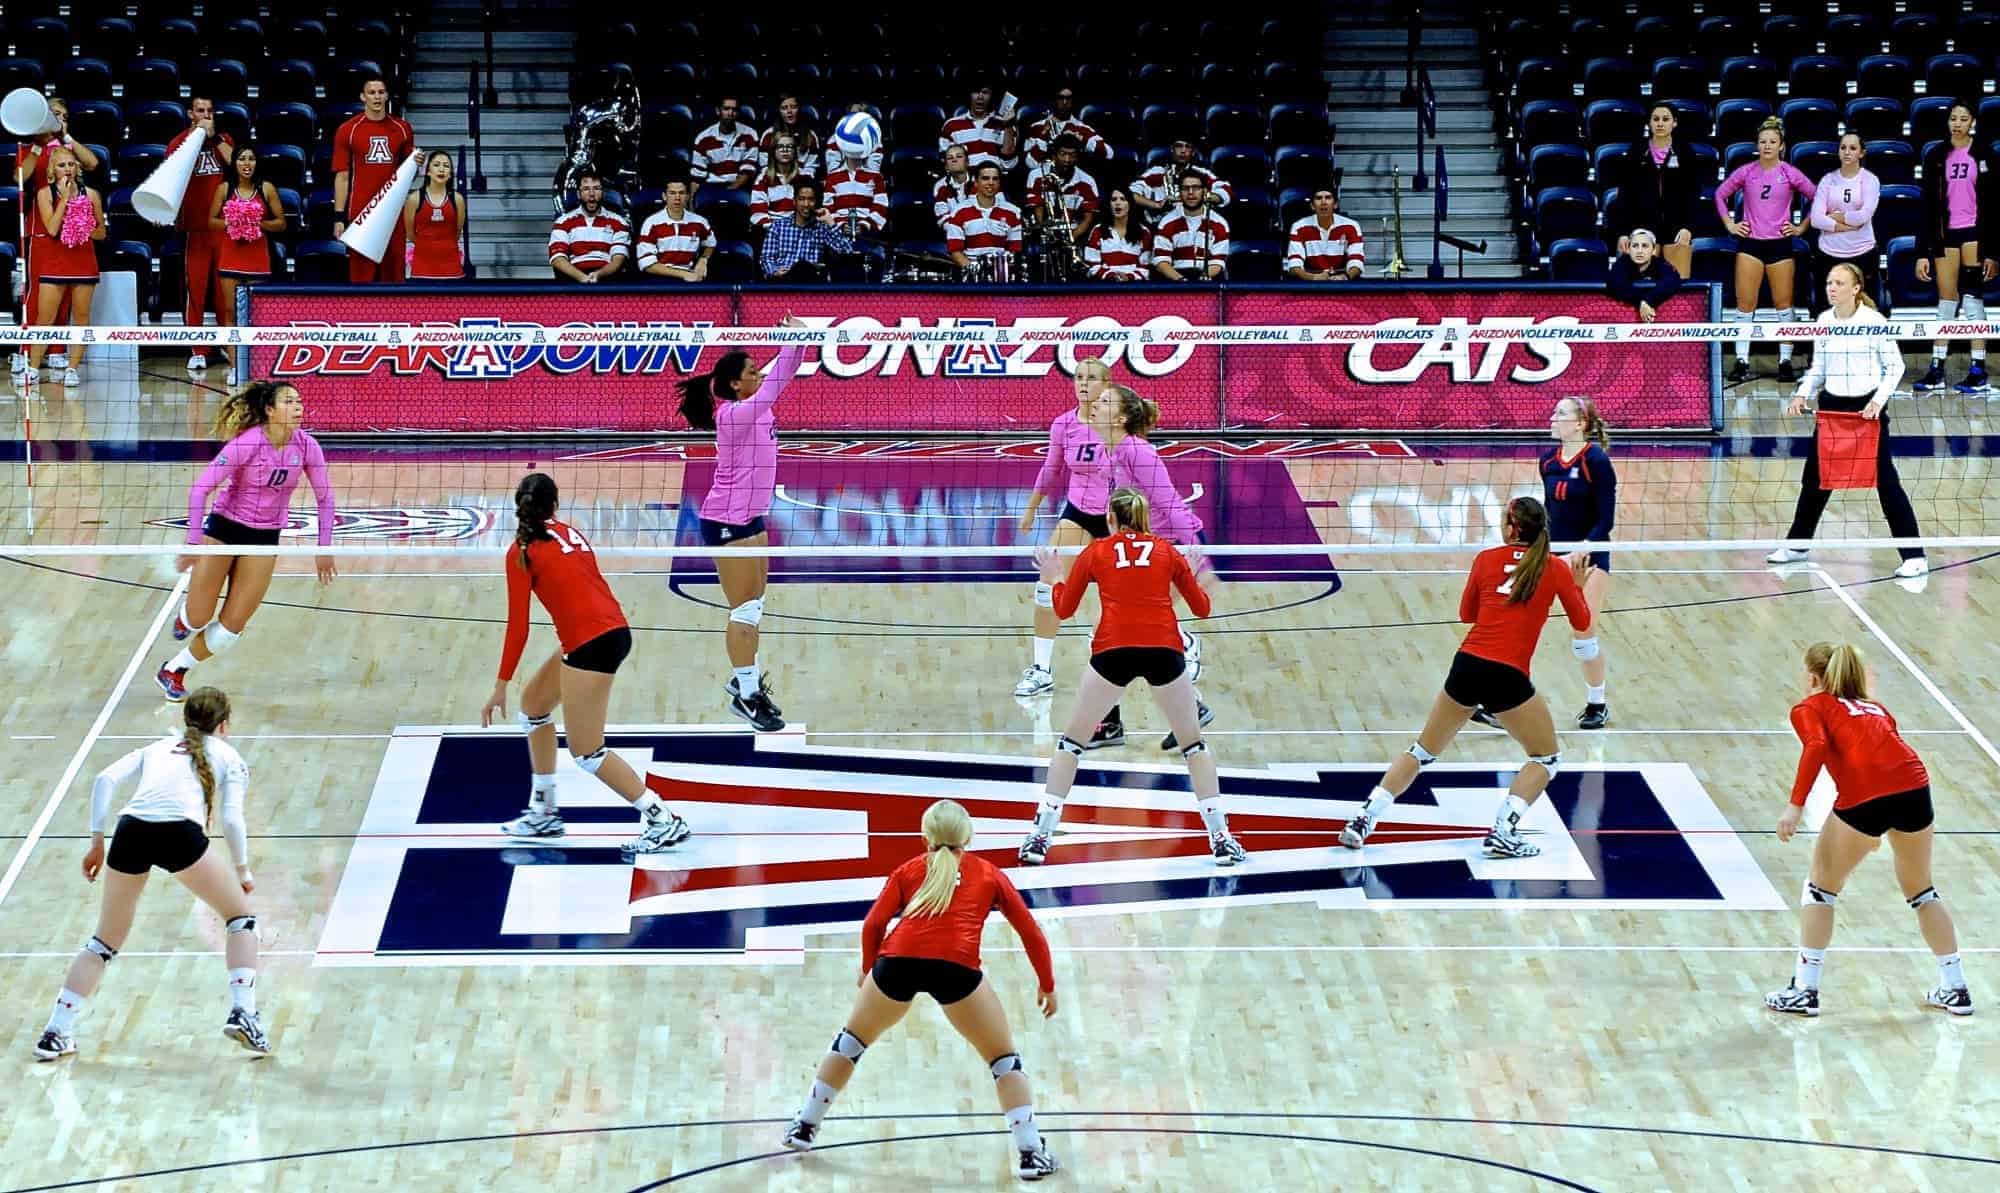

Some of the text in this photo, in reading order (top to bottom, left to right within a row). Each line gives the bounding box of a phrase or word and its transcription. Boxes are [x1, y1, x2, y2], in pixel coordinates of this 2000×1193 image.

[365, 136, 393, 164] A
[1950, 163, 1969, 179] 33
[1761, 185, 1771, 199] 2
[1843, 188, 1851, 203] 5
[1349, 316, 1580, 382] CATS
[1076, 444, 1097, 462] 15
[267, 469, 288, 487] 10
[1555, 481, 1568, 500] 11
[546, 527, 591, 554] 14
[1114, 541, 1154, 568] 17
